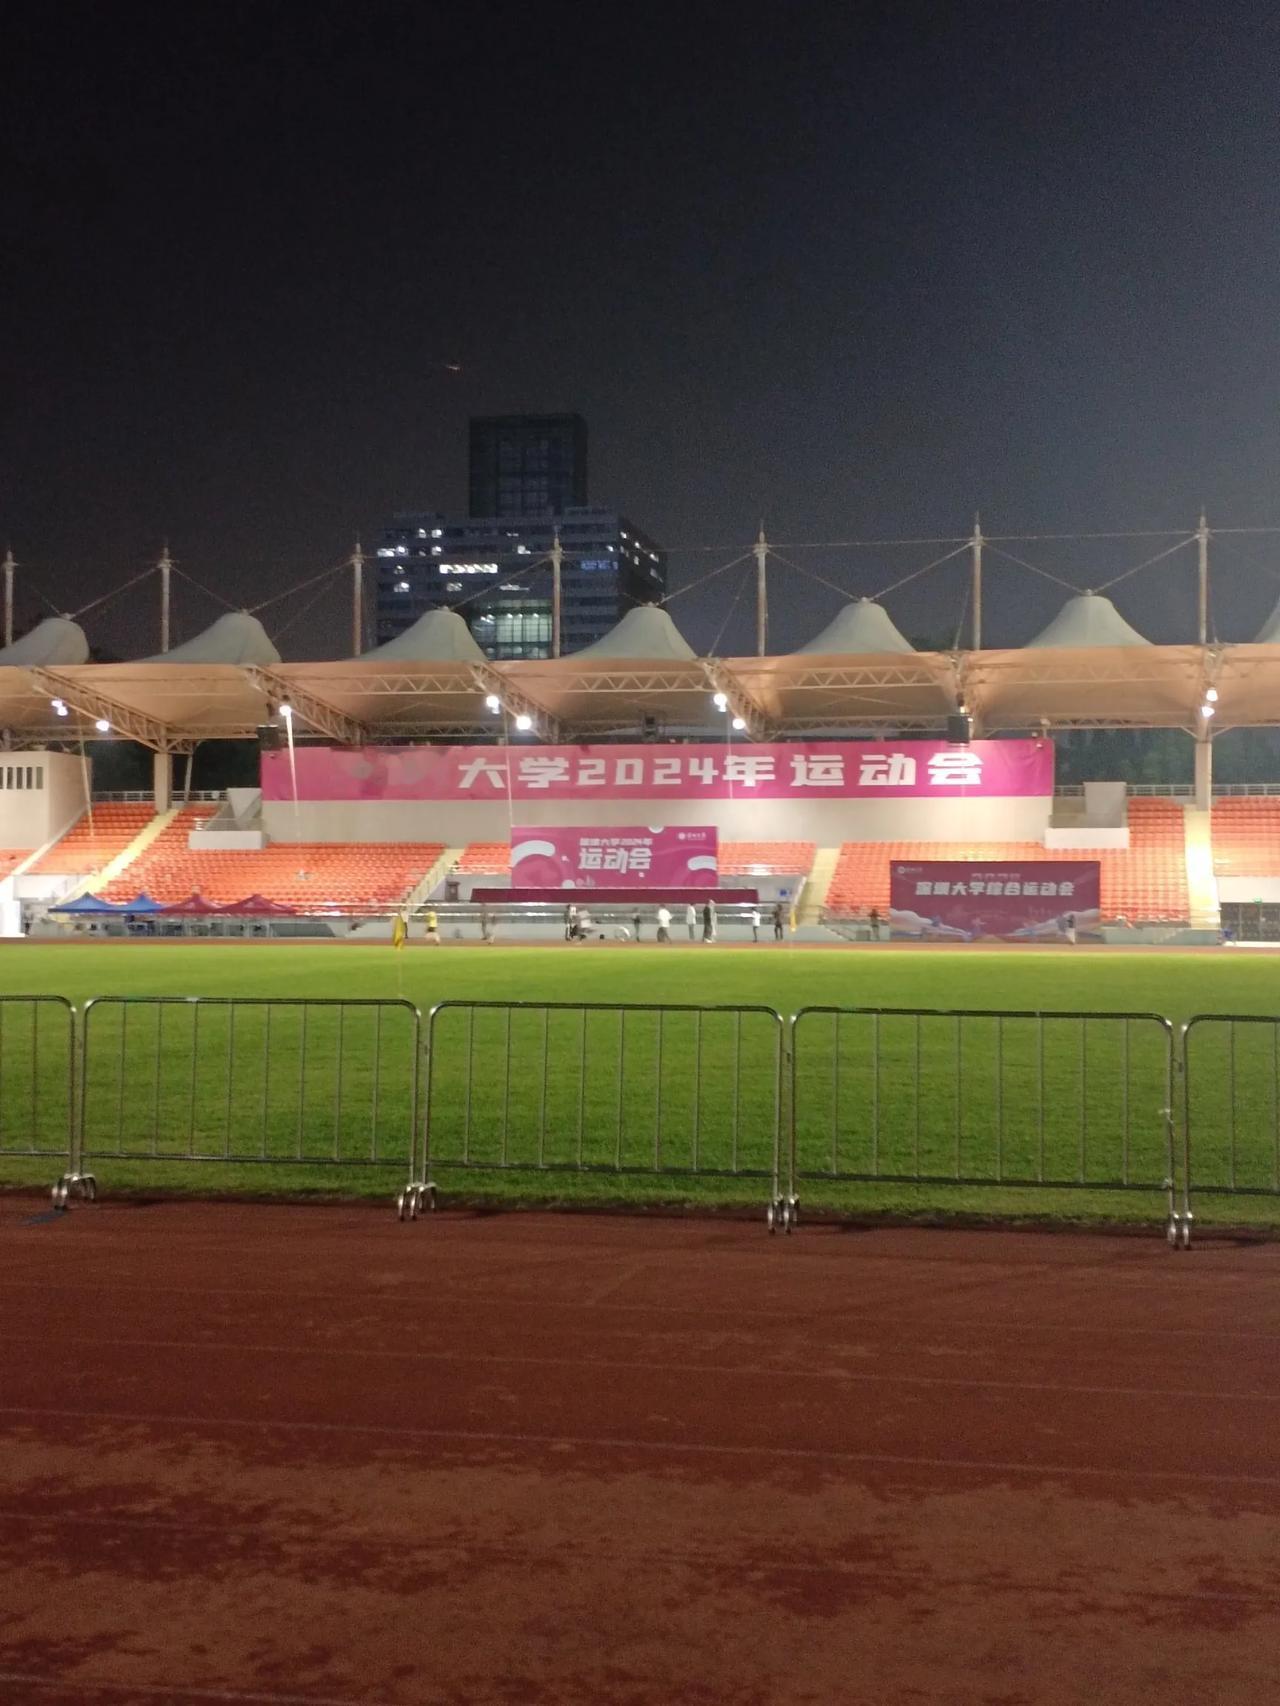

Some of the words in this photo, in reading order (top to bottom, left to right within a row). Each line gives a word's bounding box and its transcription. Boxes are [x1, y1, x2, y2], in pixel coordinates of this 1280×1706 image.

[459, 753, 984, 789] 大学2024年运动会
[578, 848, 653, 874] 运动会
